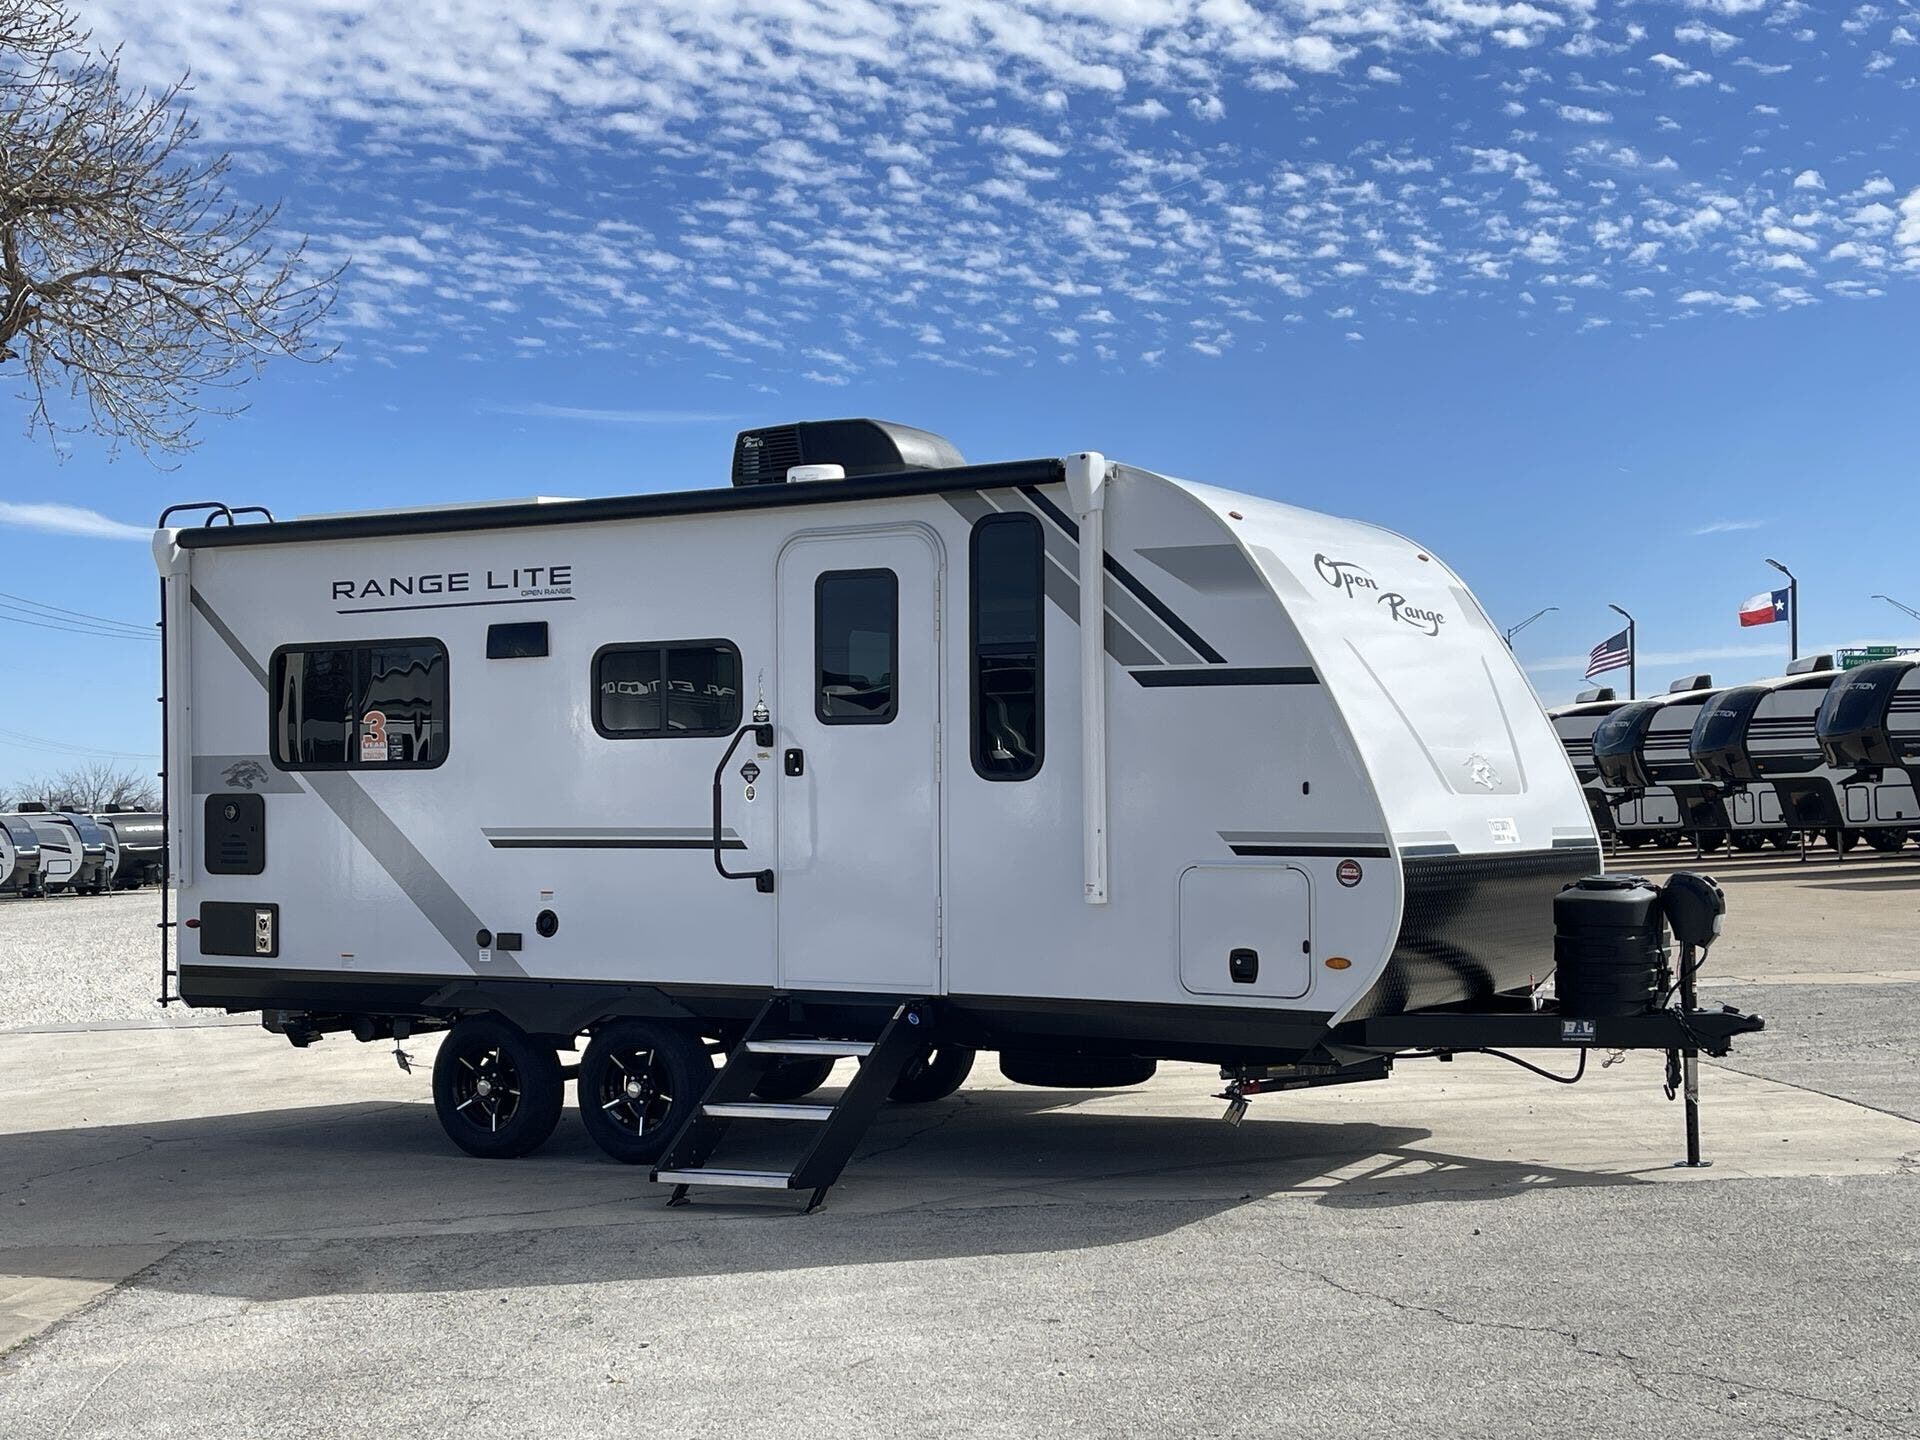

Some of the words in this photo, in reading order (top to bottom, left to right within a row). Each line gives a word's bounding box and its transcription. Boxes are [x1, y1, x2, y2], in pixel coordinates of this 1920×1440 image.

[332, 572, 470, 600] RANGE
[487, 565, 572, 590] LITE
[520, 588, 543, 597] OPEN
[544, 587, 572, 595] RANGE
[1314, 553, 1378, 599] Open
[1377, 592, 1447, 637] Range
[363, 710, 387, 742] 3
